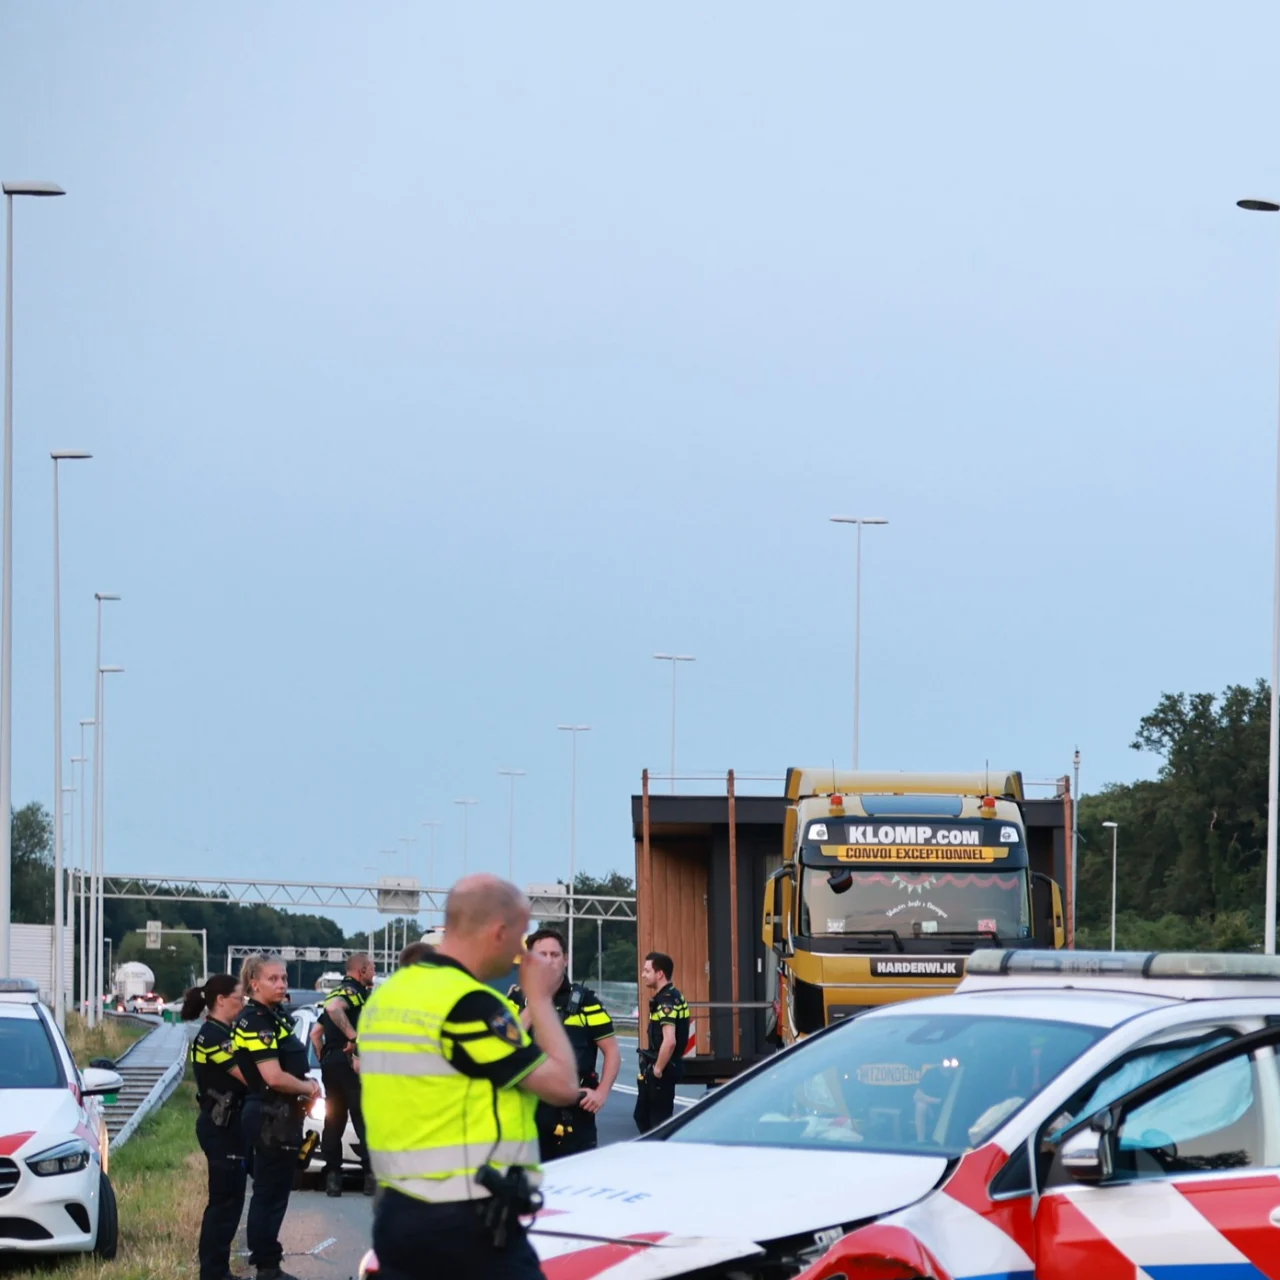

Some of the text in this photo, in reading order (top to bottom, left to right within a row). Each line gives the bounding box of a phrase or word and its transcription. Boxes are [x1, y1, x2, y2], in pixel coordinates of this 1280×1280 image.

[849, 826, 979, 845] KLOMP.COM
[846, 847, 986, 860] CONVOI EXCEPTIONNEL
[877, 962, 956, 973] HARDERWIJK
